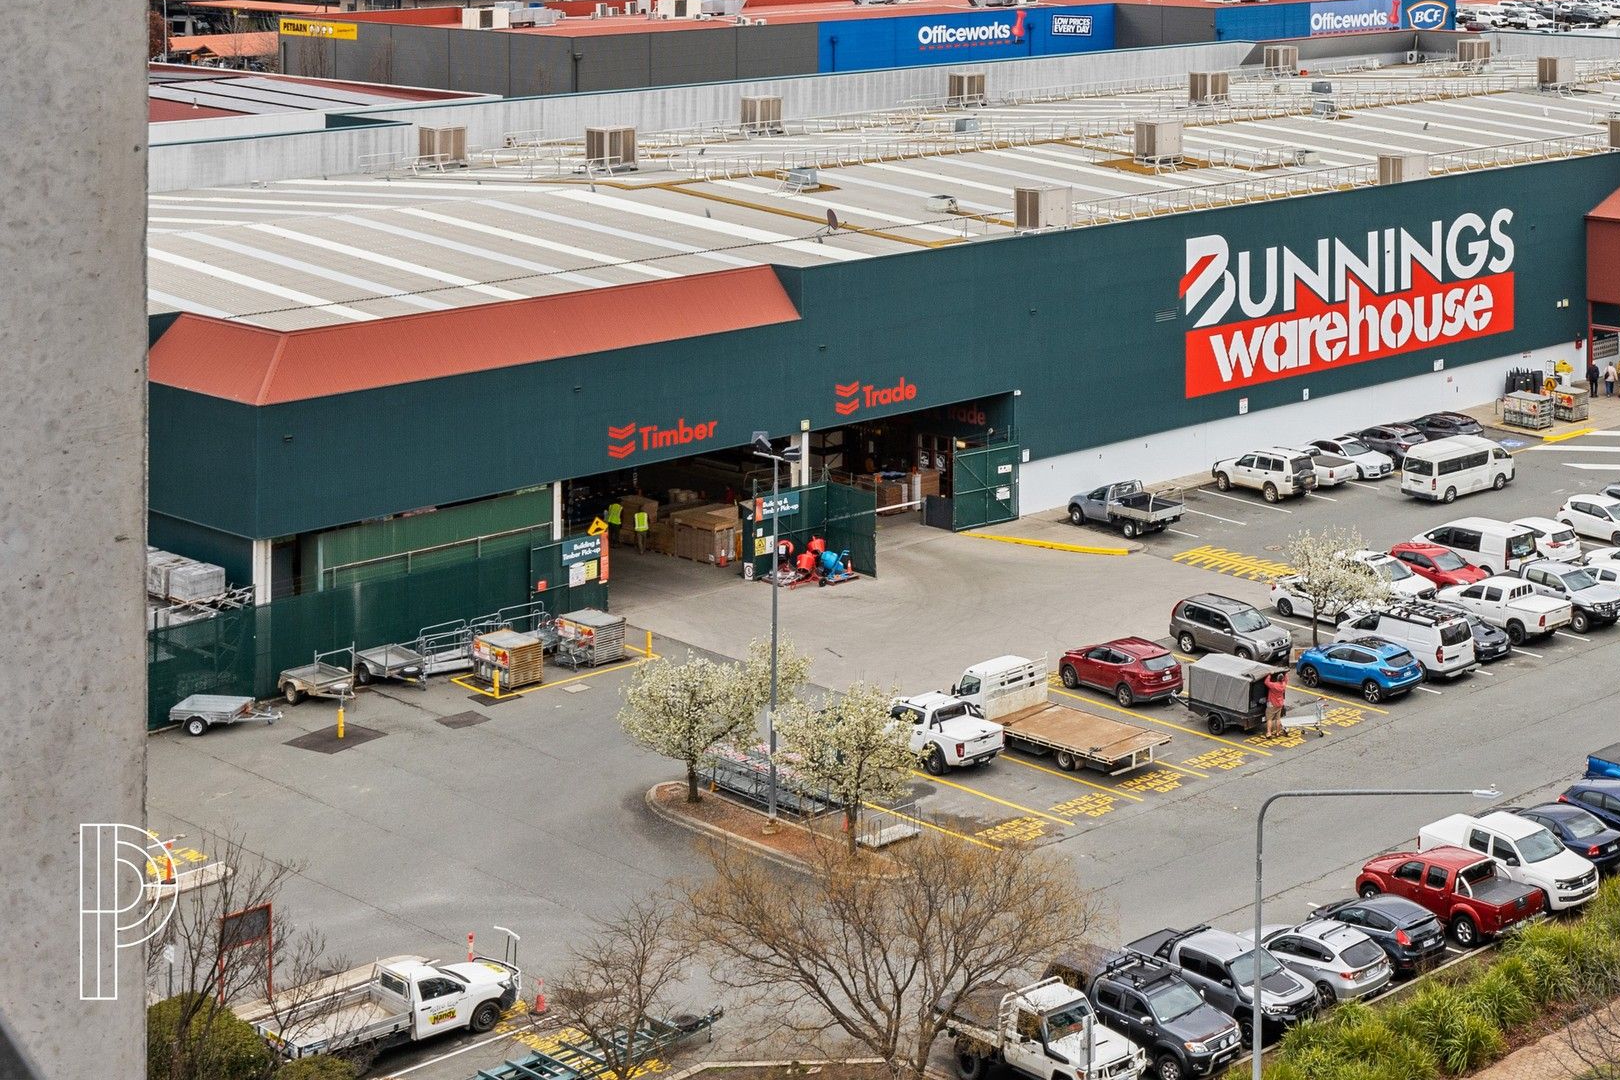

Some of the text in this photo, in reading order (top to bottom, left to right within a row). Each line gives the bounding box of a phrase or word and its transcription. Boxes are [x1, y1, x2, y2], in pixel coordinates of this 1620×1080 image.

[283, 22, 308, 33] PETBARN
[1054, 17, 1091, 26] LOW PRICES
[1311, 9, 1388, 31] Officeworks
[918, 21, 1011, 45] Officeworks
[1054, 24, 1090, 34] EVERY DAY
[1181, 208, 1515, 328] BUNNINGS
[1209, 283, 1494, 382] warehouse
[862, 376, 917, 408] Trade
[639, 417, 718, 451] Timber
[763, 499, 783, 508] Buildg
[763, 503, 799, 515] Timbr Pick-up
[574, 538, 601, 551] Building &
[562, 547, 601, 561] Timber Pick-up
[1181, 750, 1222, 766] TRADE
[1193, 751, 1249, 770] TRAILER
[1218, 758, 1246, 771] BAY
[1115, 771, 1161, 790] TRADE
[1126, 772, 1186, 793] TRAILER
[1153, 780, 1182, 793] BAY
[1048, 794, 1093, 813] TRADE
[1059, 795, 1120, 817] TRAILER
[1085, 804, 1116, 818] BAY
[431, 1009, 457, 1025] Handy
